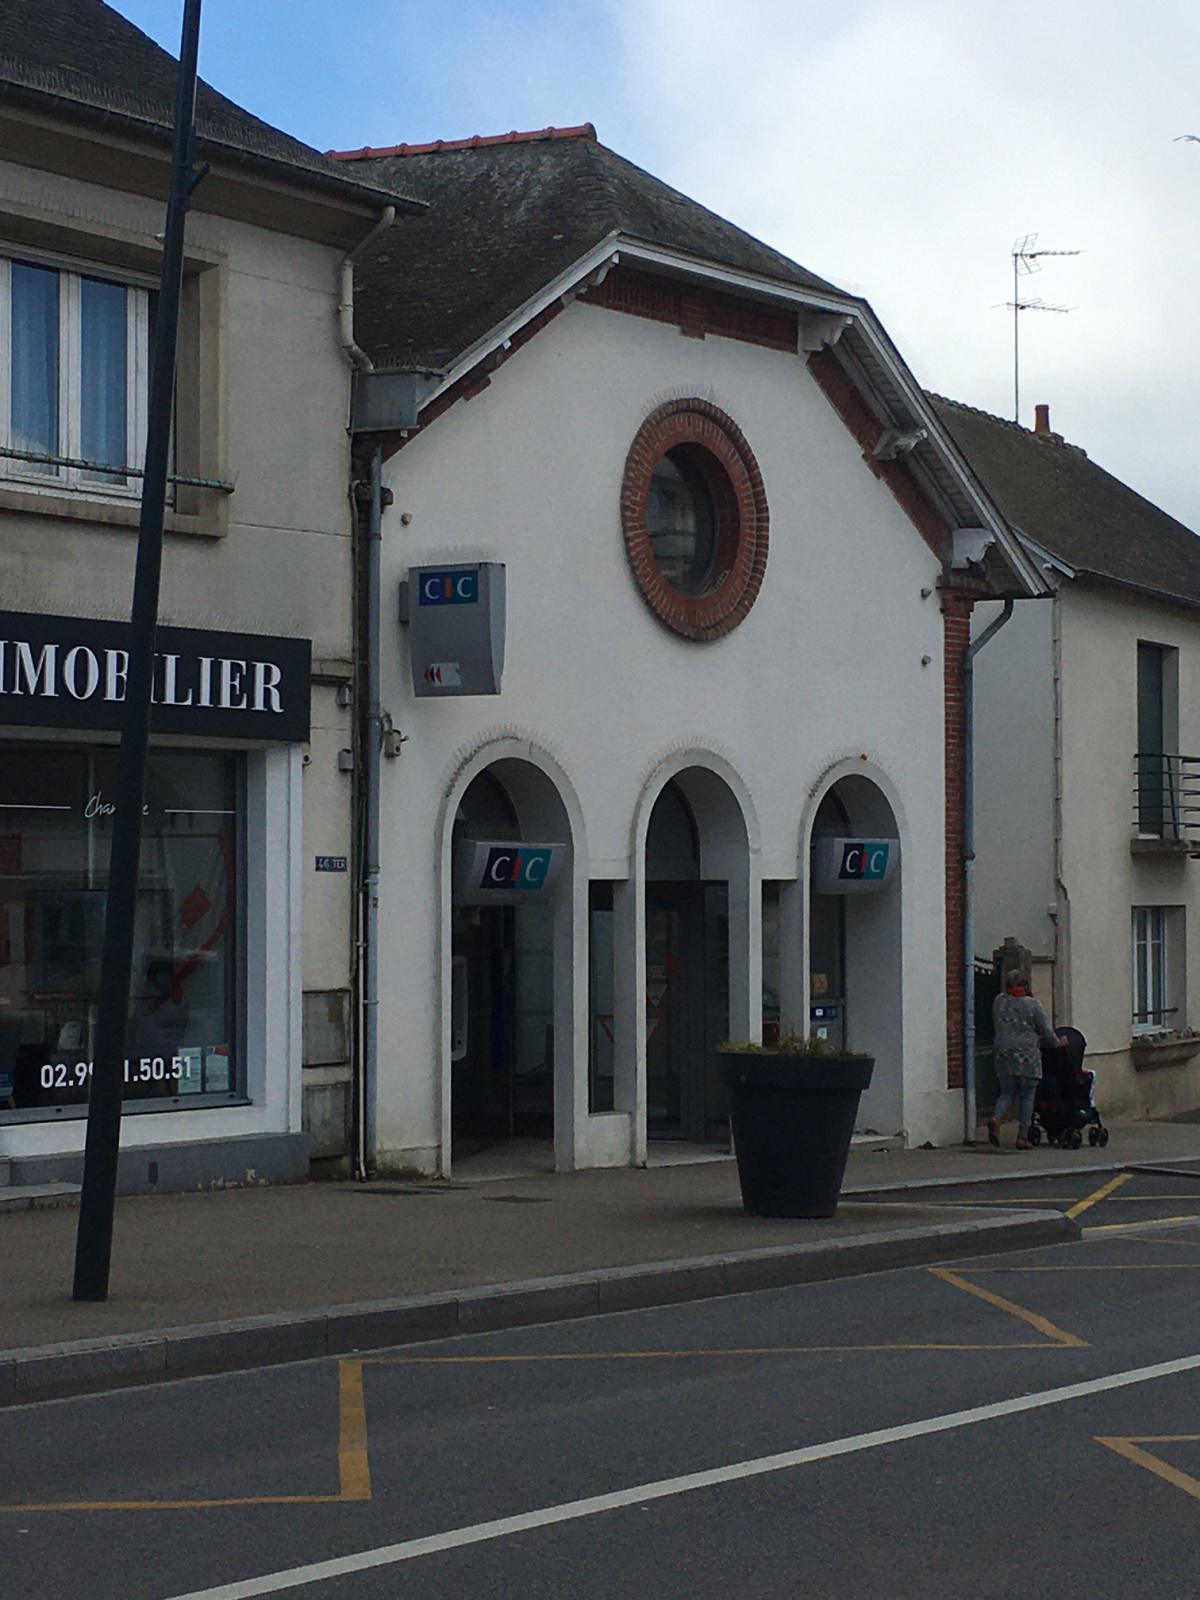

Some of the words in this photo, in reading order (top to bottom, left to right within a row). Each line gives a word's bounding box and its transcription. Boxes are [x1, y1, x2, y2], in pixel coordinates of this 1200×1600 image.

[424, 577, 473, 599] CIC
[0, 639, 284, 713] MOBLIER
[490, 855, 544, 882] CIC
[845, 849, 884, 873] CIC
